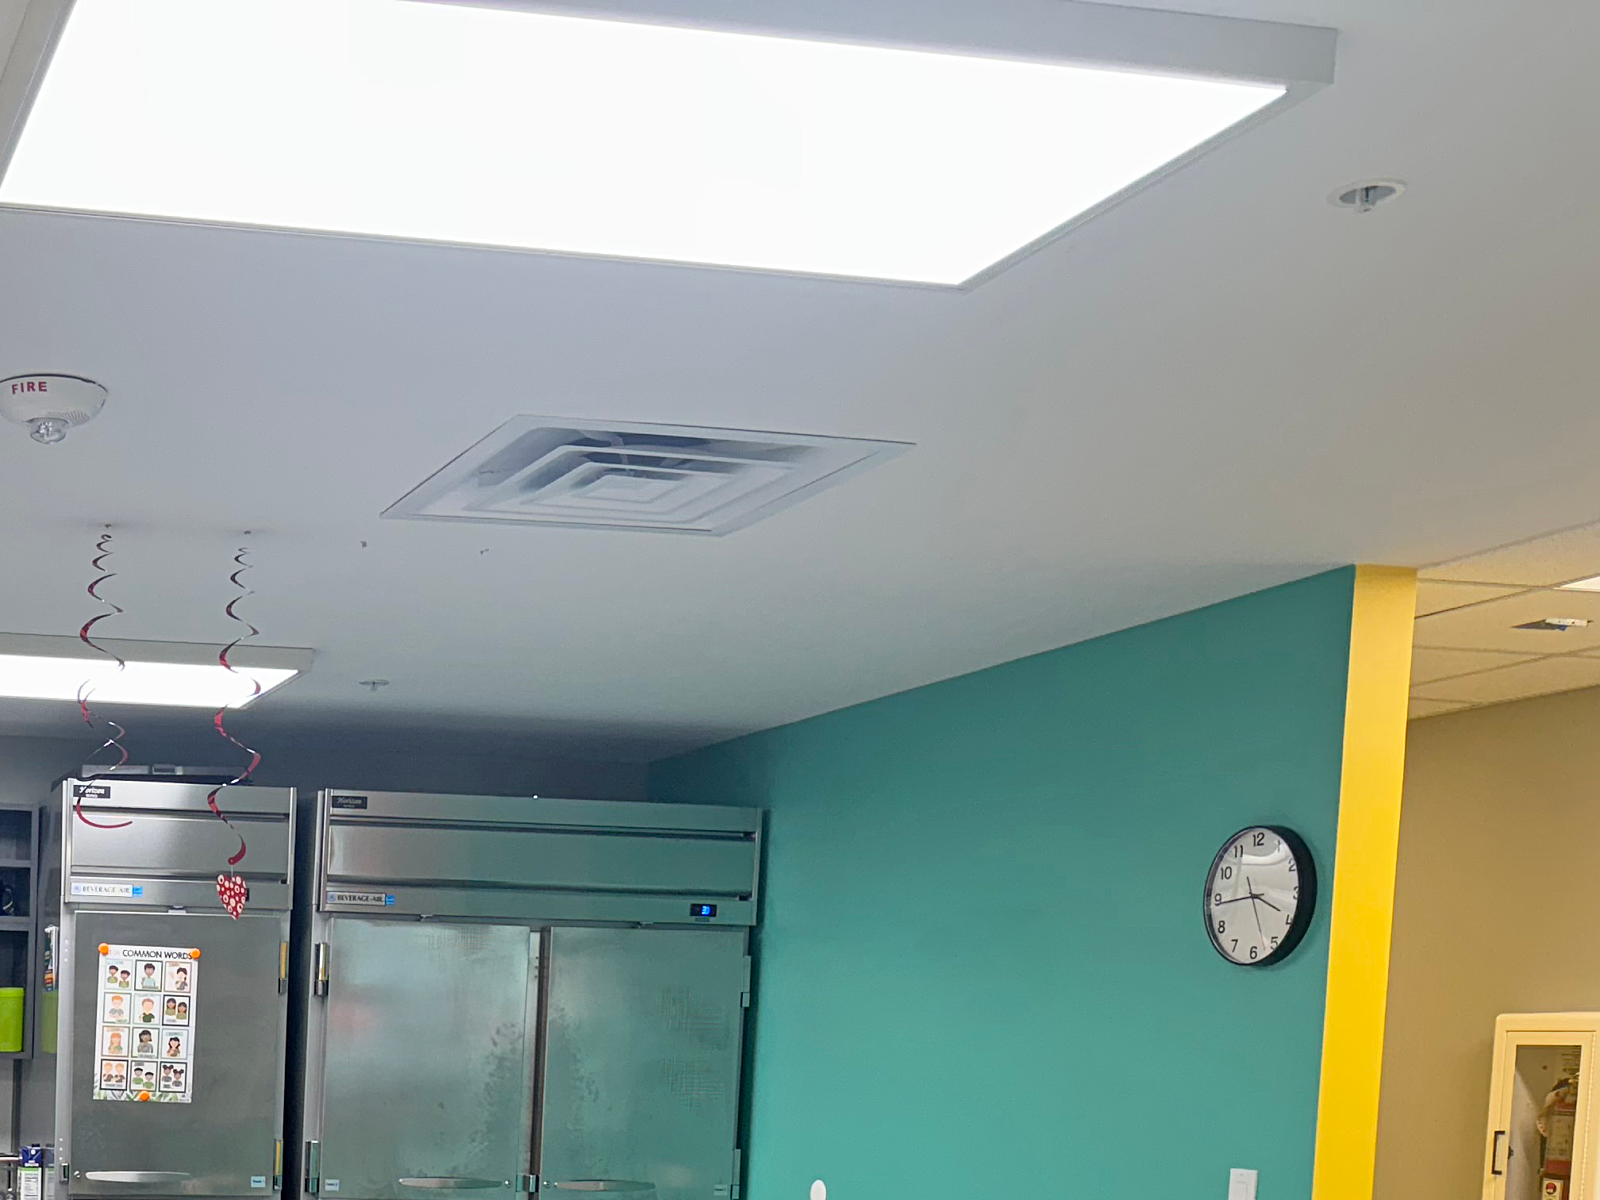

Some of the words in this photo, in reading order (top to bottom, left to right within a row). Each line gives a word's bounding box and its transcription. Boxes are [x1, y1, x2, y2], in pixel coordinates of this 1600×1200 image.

[11, 381, 47, 395] FIRE
[1252, 832, 1265, 847] 12
[1276, 839, 1281, 853] 1
[1234, 845, 1244, 857] 11
[1287, 858, 1296, 872] 2
[1220, 866, 1232, 880] 10
[1214, 893, 1222, 906] 9
[1293, 886, 1299, 900] 3
[1217, 920, 1226, 934] 8
[1231, 939, 1239, 953] 7
[1270, 936, 1279, 950] 5
[122, 949, 162, 959] COMMON
[164, 951, 192, 960] WORDS
[1249, 946, 1258, 960] 6
